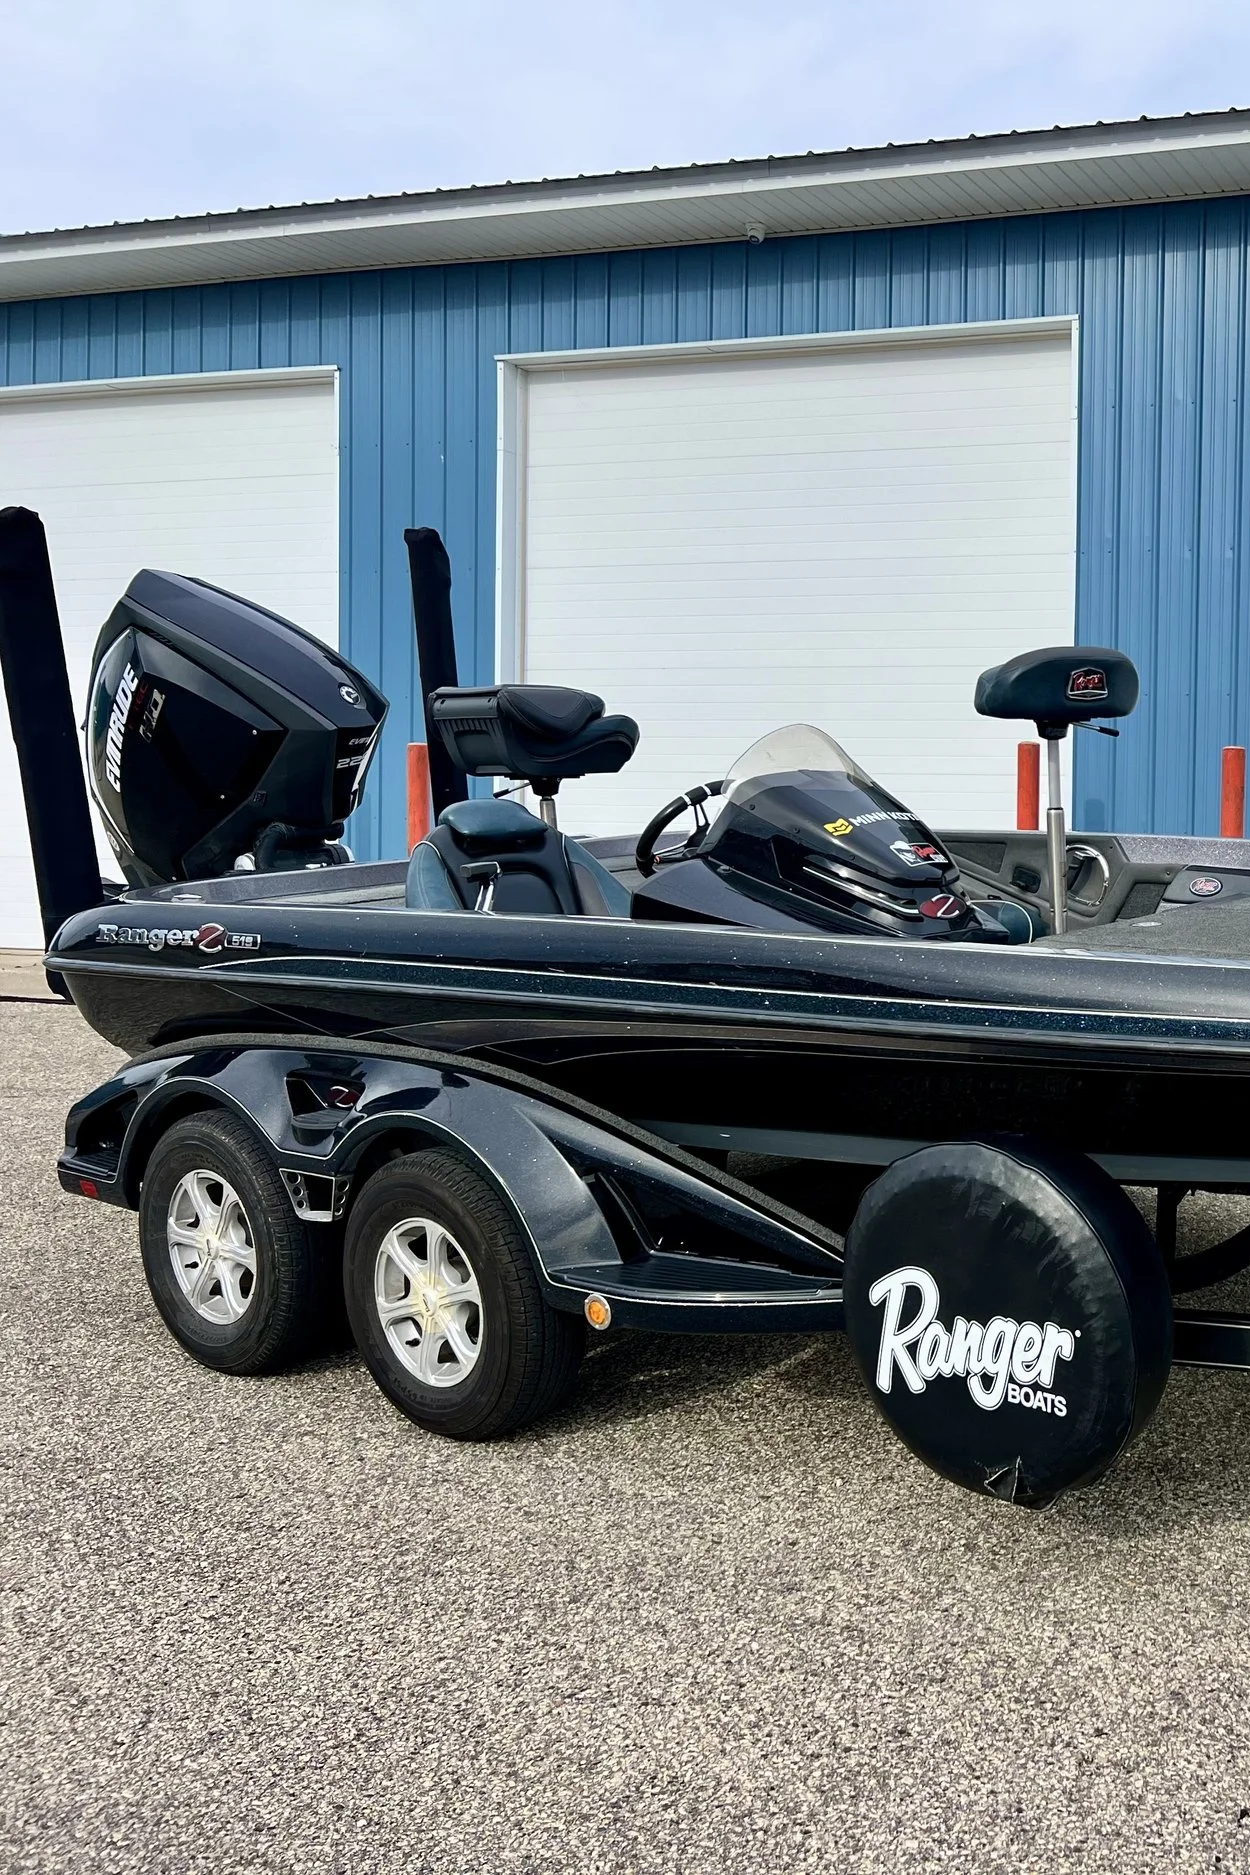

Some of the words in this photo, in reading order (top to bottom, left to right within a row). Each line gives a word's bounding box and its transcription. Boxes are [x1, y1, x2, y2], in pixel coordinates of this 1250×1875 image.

[105, 662, 138, 792] EVINRUDE
[848, 811, 891, 827] MINN
[96, 924, 199, 951] Ranger
[869, 1266, 1075, 1411] Ranger
[1007, 1384, 1068, 1417] BOATS
